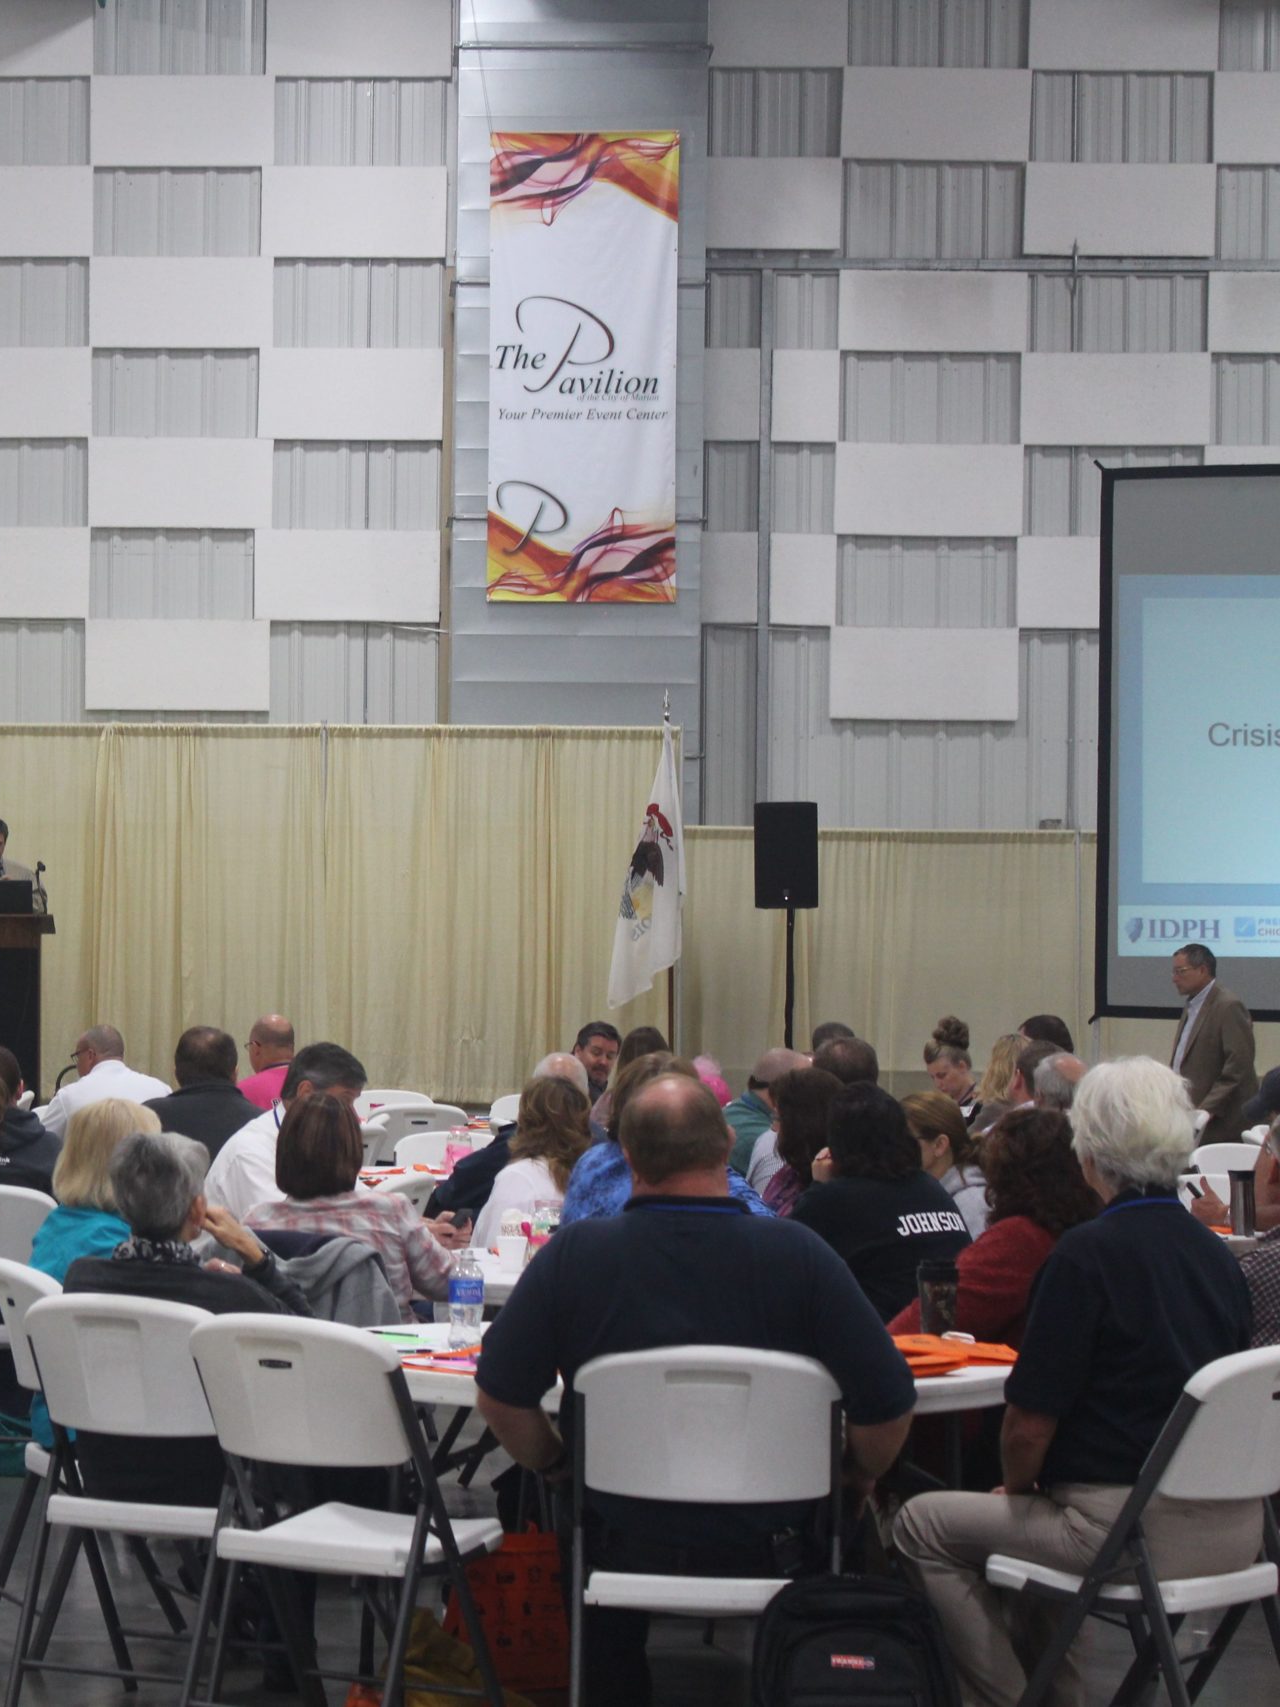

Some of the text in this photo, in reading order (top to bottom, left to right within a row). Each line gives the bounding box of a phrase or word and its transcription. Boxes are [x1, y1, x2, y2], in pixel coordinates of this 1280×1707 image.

[495, 295, 659, 395] The Pavilion
[498, 408, 668, 420] Your Premier Event Center
[1148, 919, 1220, 939] IDPH
